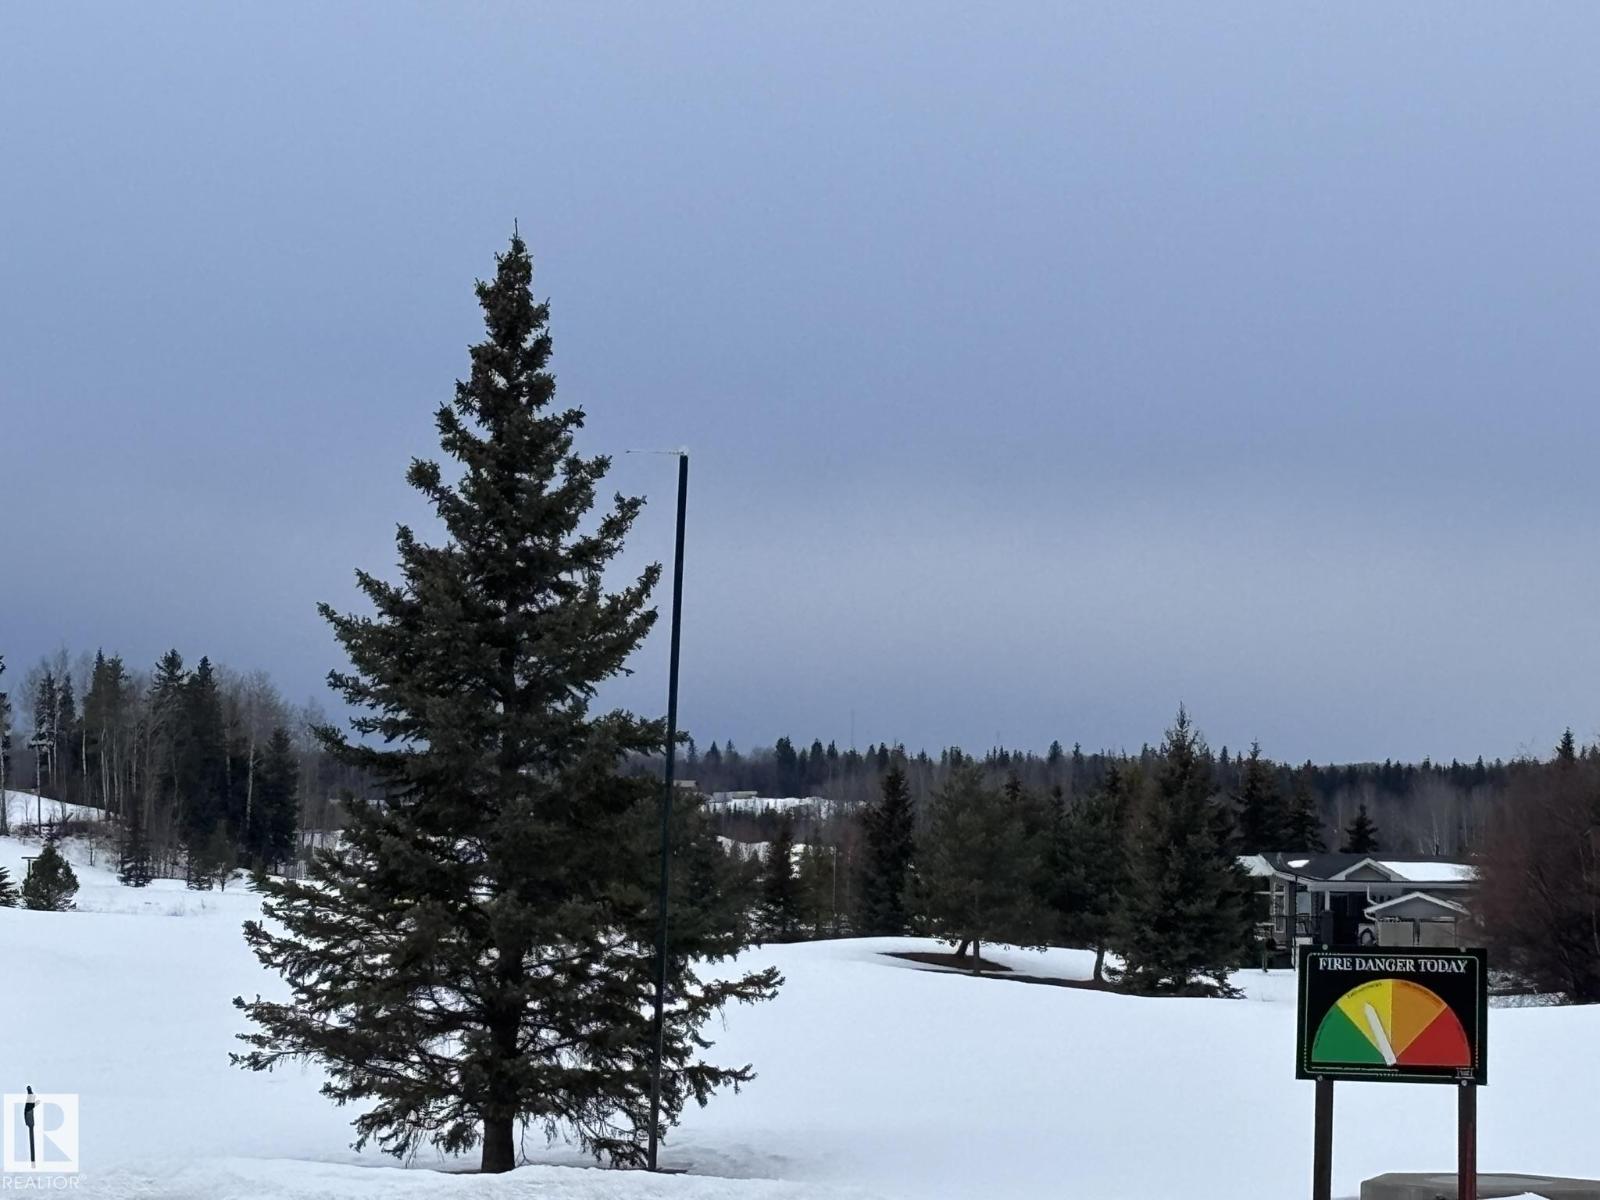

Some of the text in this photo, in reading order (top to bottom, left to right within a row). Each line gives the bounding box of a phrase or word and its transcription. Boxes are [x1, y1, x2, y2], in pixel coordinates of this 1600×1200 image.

[1319, 957, 1468, 973] FIRE DANGER TODAY
